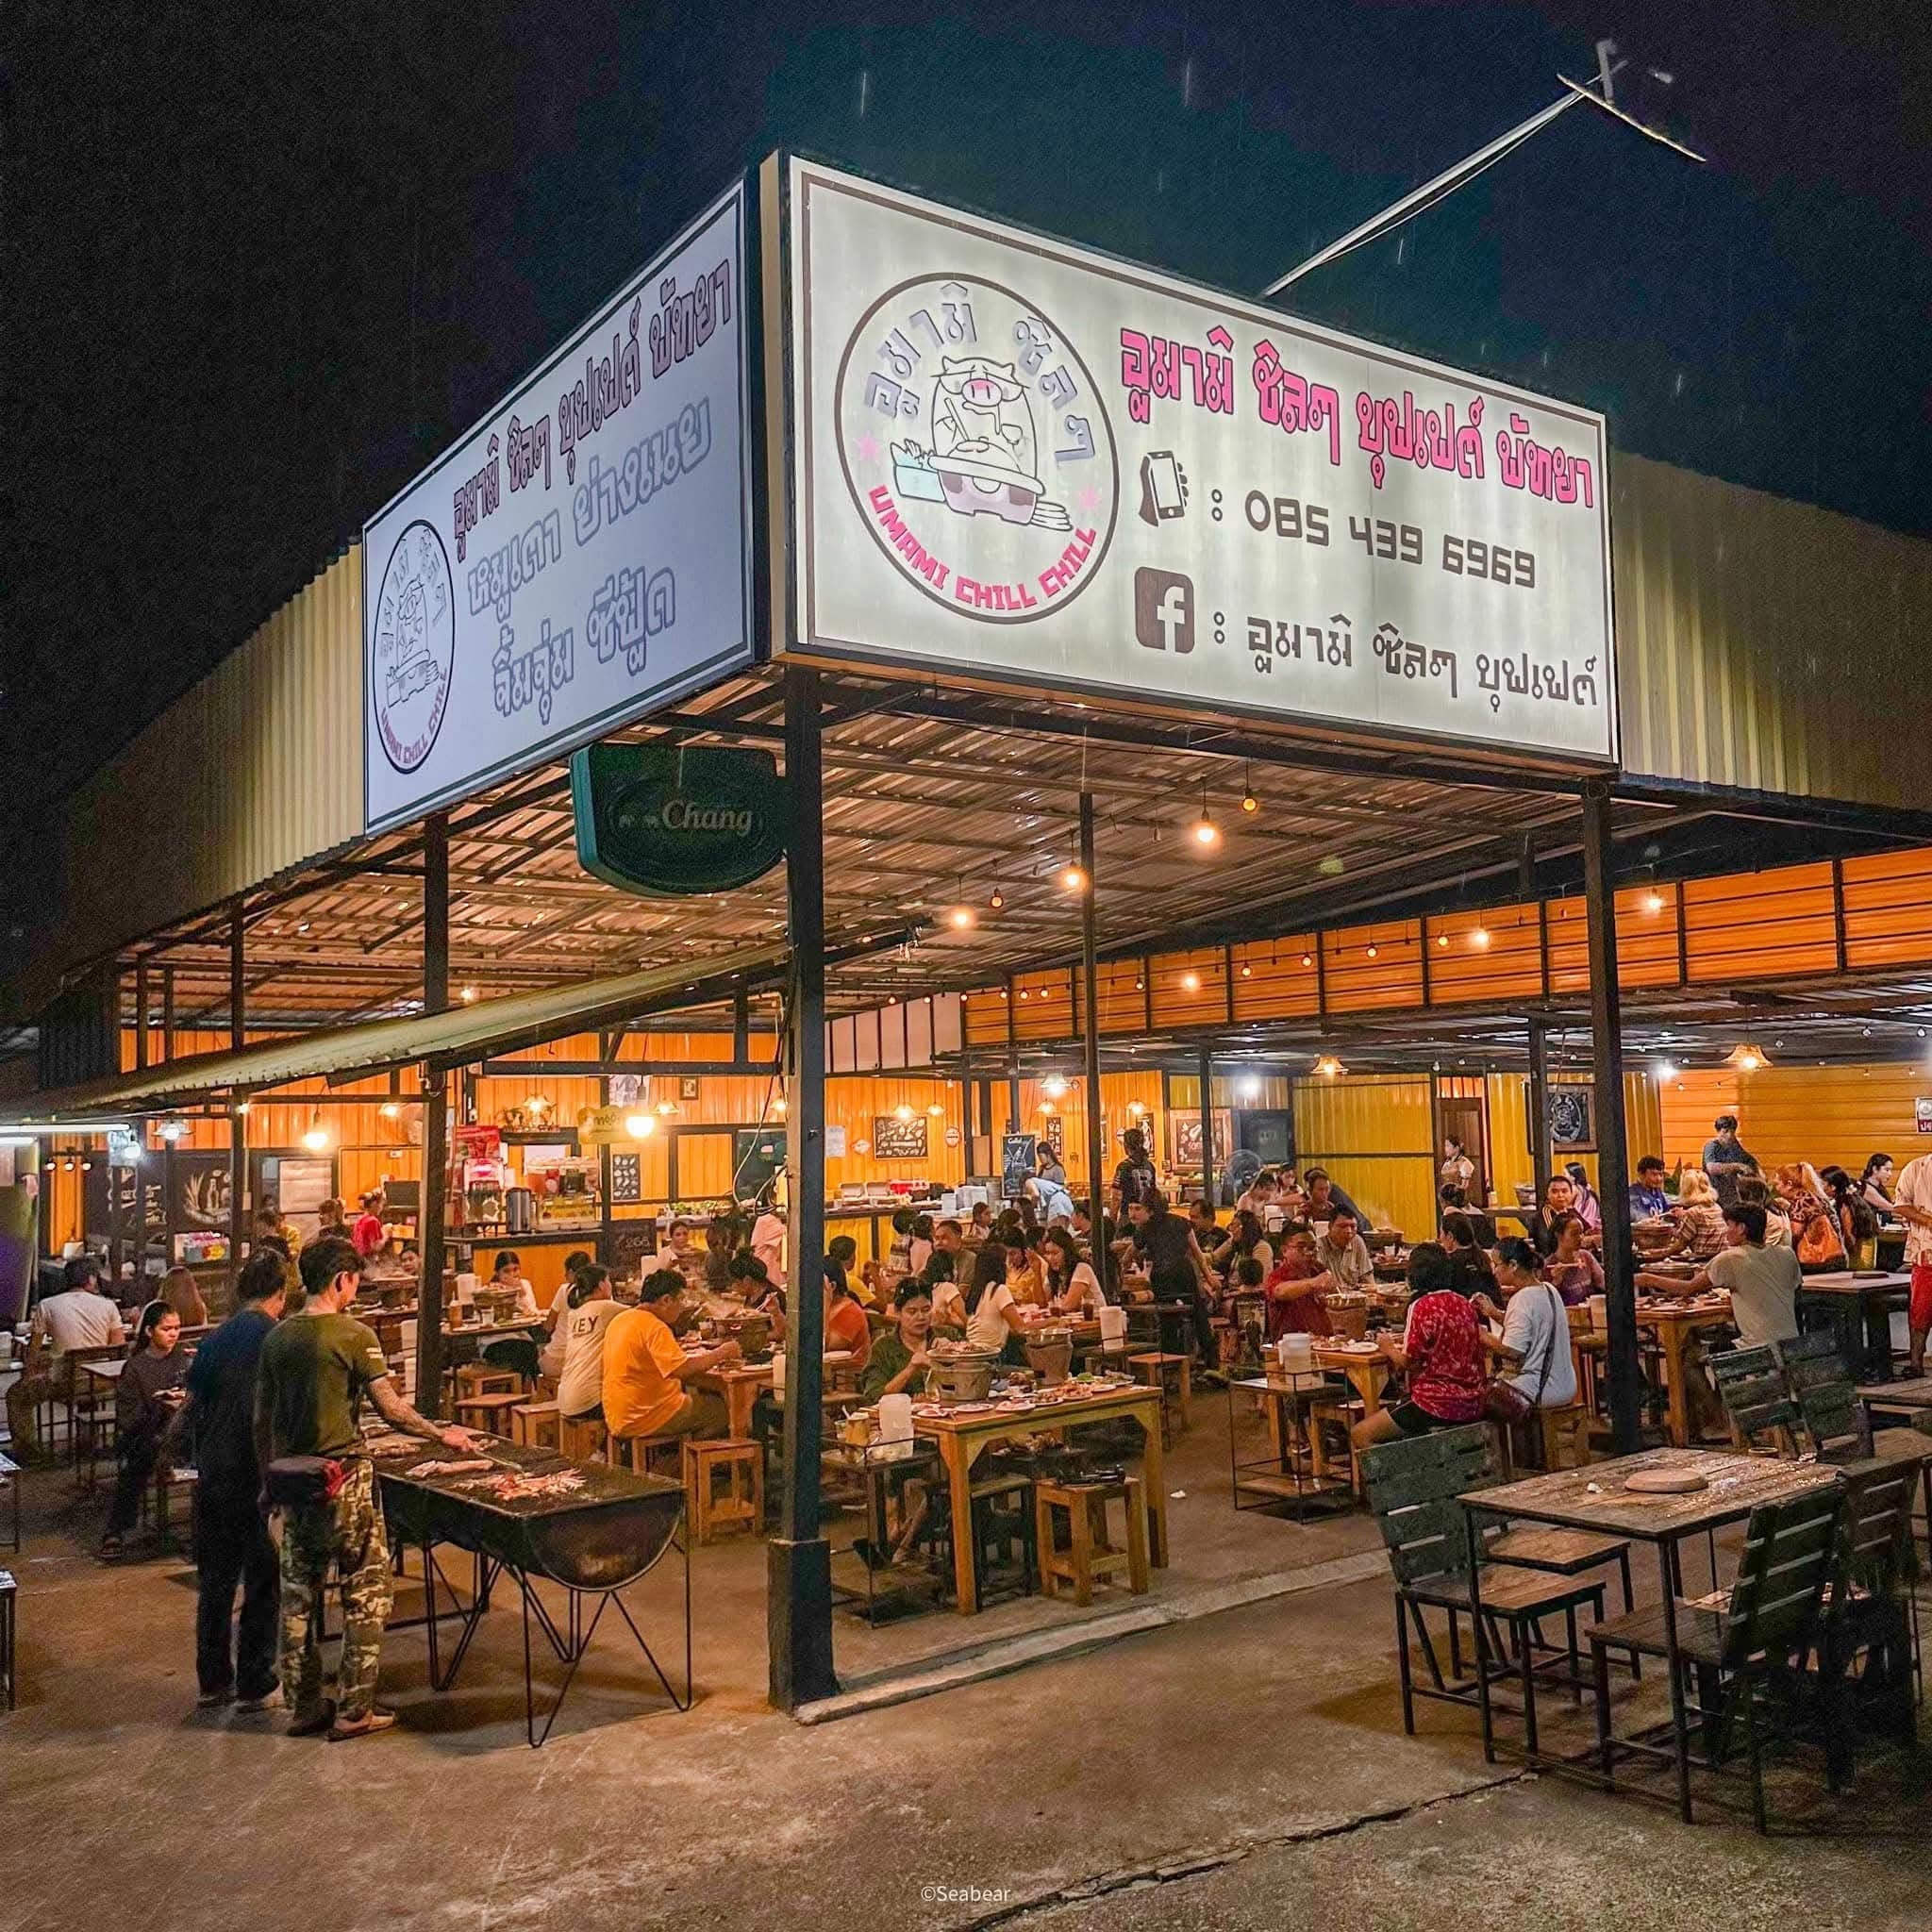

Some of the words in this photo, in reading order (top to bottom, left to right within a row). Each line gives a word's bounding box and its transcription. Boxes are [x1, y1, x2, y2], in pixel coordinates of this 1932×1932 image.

[454, 433, 499, 563] อูมามิ
[558, 295, 641, 485] บุฟเฟต์
[649, 258, 731, 379] พัทยา
[574, 395, 711, 546] ย่างเนย
[1121, 325, 1234, 424] อูมามิ
[1356, 391, 1486, 490] บุฟเฟต์
[1496, 413, 1593, 508] พัทยา
[868, 484, 950, 590] UMAMI
[955, 575, 1038, 610] CHILL
[1038, 527, 1097, 598] CHILL
[1245, 490, 1329, 546] 085
[1349, 516, 1423, 565] 439
[1442, 534, 1535, 589] 6969
[492, 618, 574, 725] จิ้มจุ่ม
[587, 565, 675, 677] ซีฟู้ด
[1247, 613, 1352, 674] อูมามิ
[1475, 653, 1597, 713] บุฟเฟต์
[662, 799, 753, 838] Chang
